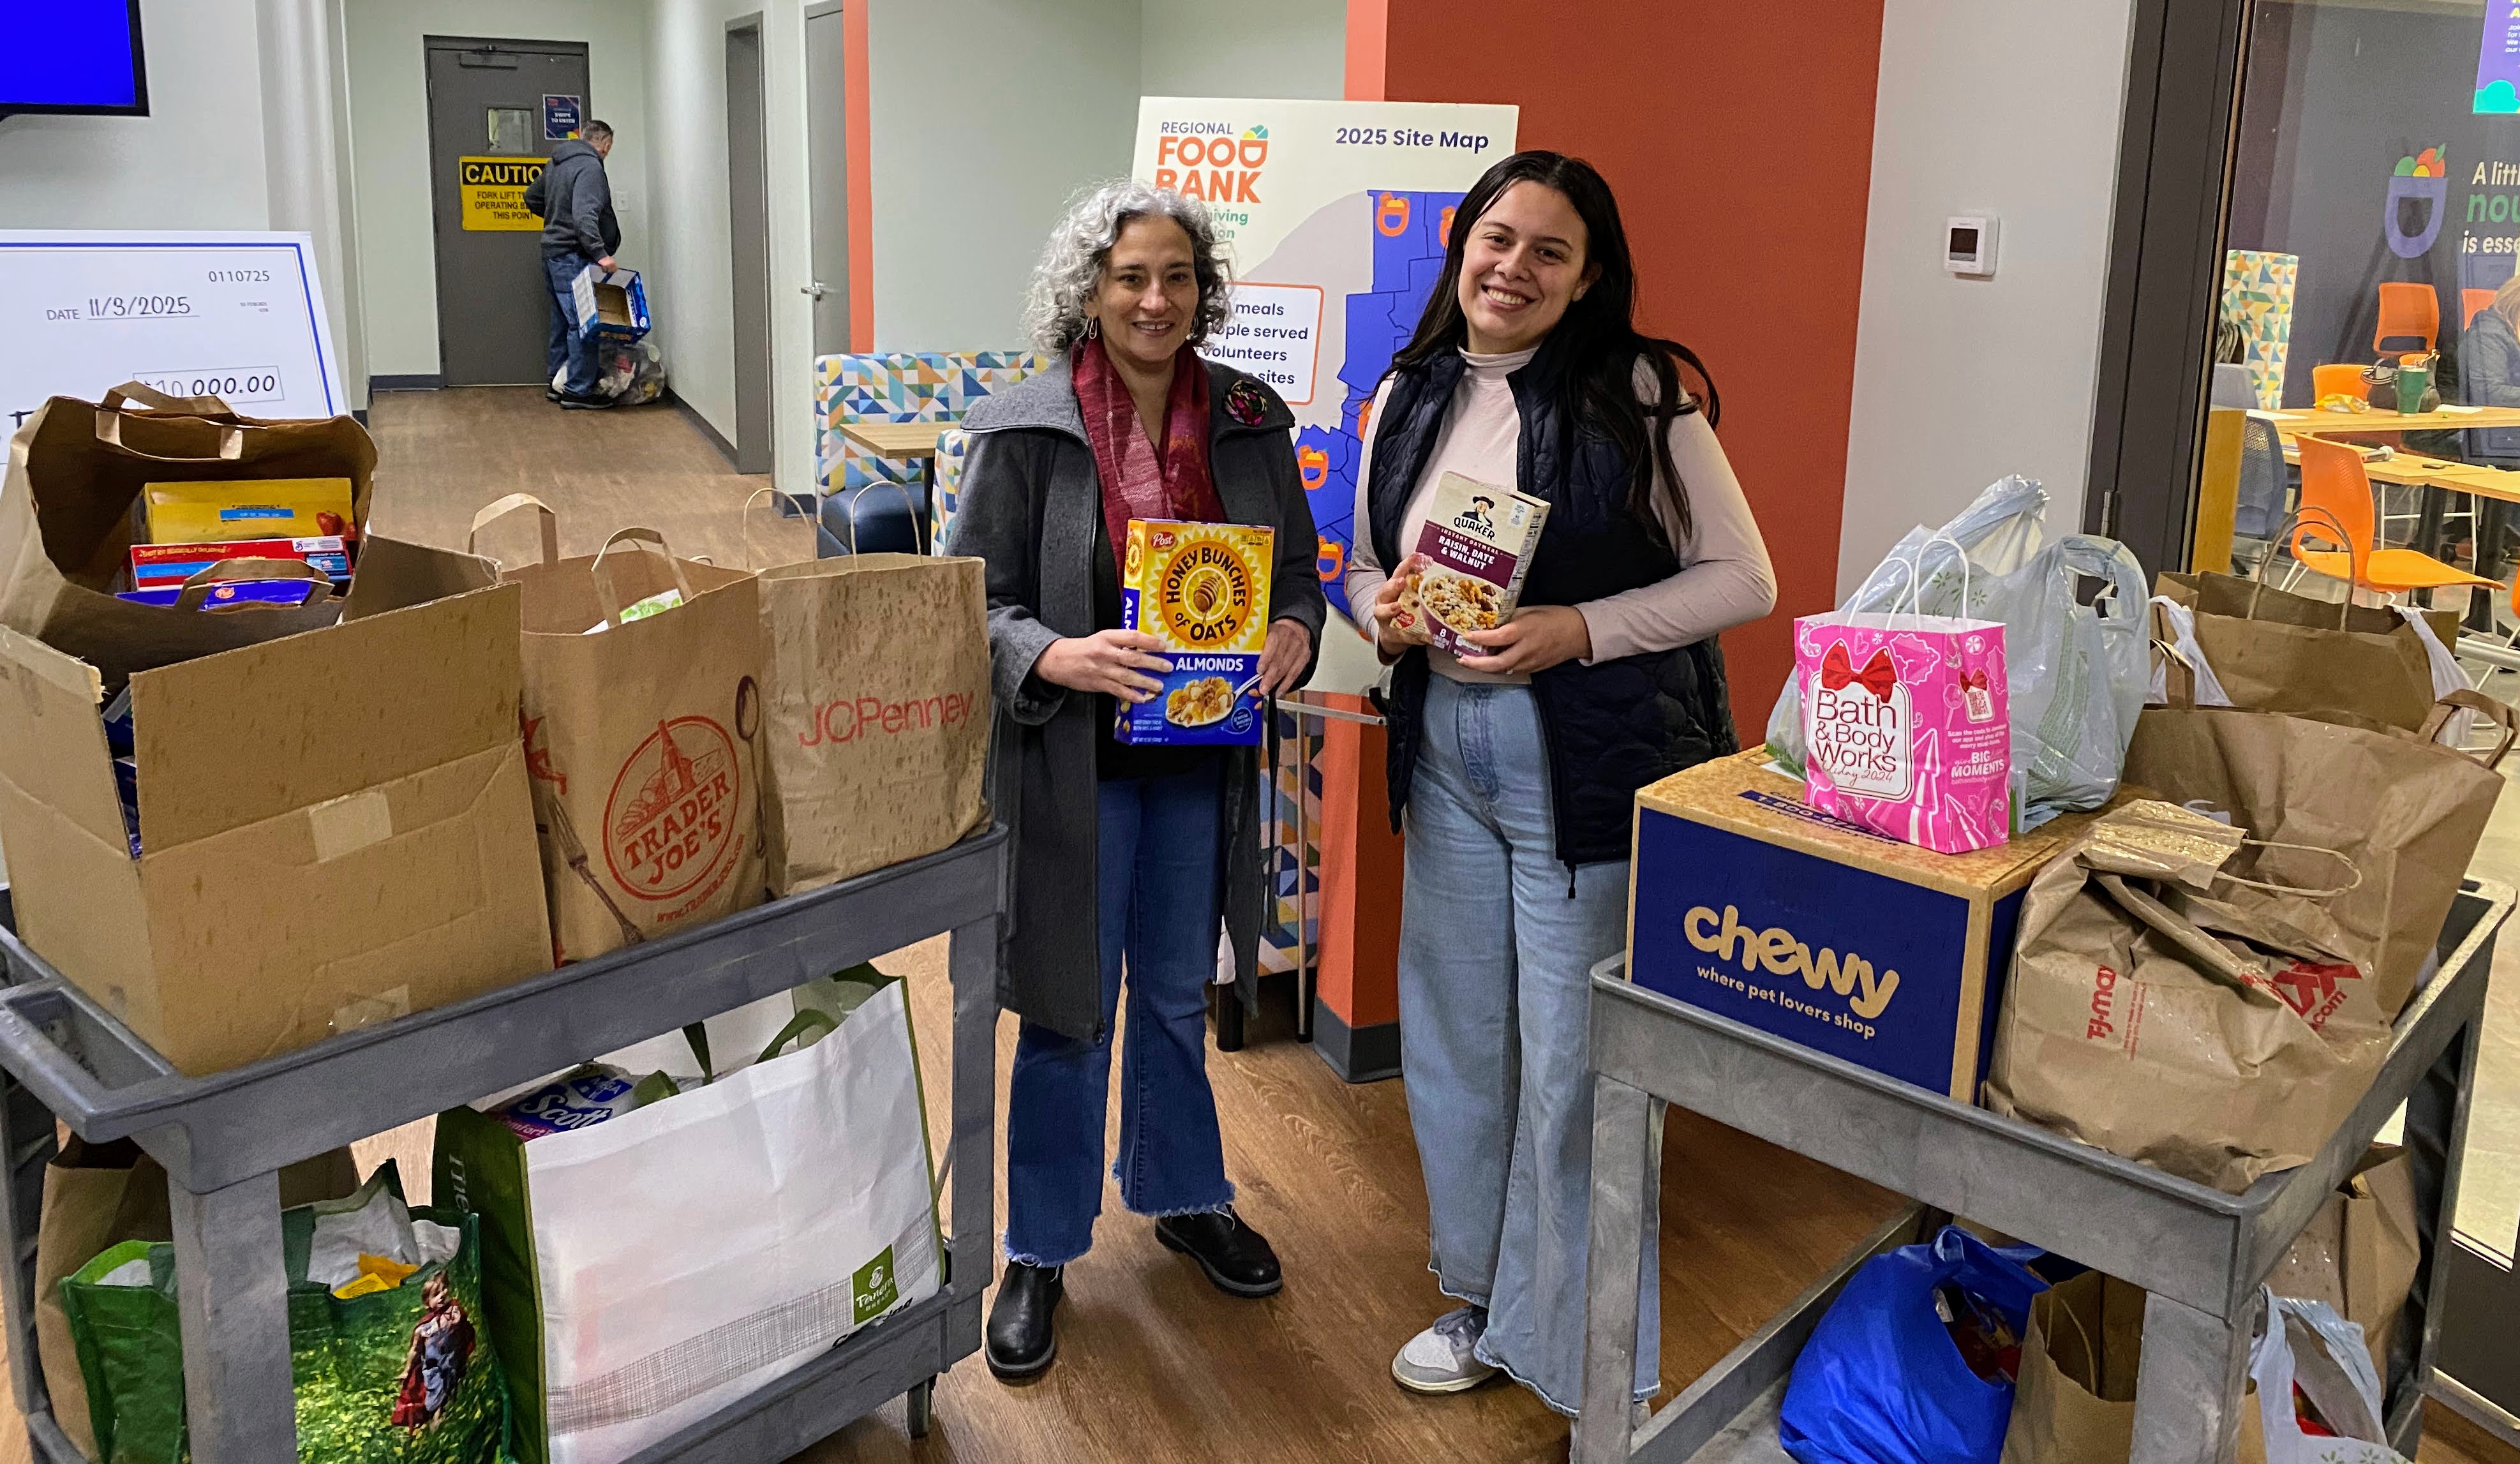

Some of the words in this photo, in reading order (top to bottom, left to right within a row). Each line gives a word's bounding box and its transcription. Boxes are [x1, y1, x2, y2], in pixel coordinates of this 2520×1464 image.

[1161, 122, 1233, 134] REGIONAL
[1158, 136, 1268, 168] FOOD
[1336, 128, 1387, 145] 2025
[1393, 130, 1433, 147] Site
[1440, 131, 1489, 153] Map
[466, 165, 542, 183] CAUTIO
[2472, 161, 2487, 184] A
[2491, 161, 2520, 185] littl
[1156, 168, 1262, 203] BANK
[1211, 209, 1249, 225] iving
[1214, 226, 1235, 239] ion
[2462, 230, 2477, 253] is
[209, 271, 269, 282] 0110725
[47, 309, 80, 320] DATE
[1235, 303, 1284, 315] meals
[1226, 324, 1249, 339] ple
[1254, 327, 1308, 340] served
[1258, 370, 1295, 384] sites
[1152, 532, 1174, 547] Post
[1454, 517, 1495, 541] QUAKER
[1449, 549, 1486, 570] WALNUT
[1472, 549, 1495, 564] DATE
[1167, 550, 1197, 604] HONEY
[1202, 547, 1246, 607] BUNCHES
[1190, 614, 1237, 640] OATS
[1440, 628, 1447, 637] 8
[1176, 657, 1244, 671] ALMONDS
[798, 691, 974, 746] JCPenney
[1817, 690, 1896, 729] Bath
[1815, 721, 1831, 741] &
[1835, 724, 1895, 753] Body
[1815, 738, 1896, 773] Works
[1971, 751, 1990, 764] BIG
[1861, 770, 1892, 783] 2024
[1951, 759, 2004, 778] MOMENTS
[624, 771, 731, 870] TRADER
[647, 809, 722, 885] JOE'S
[1684, 905, 1900, 1019] chewy
[1697, 966, 1744, 992] where
[1748, 985, 1776, 1004] pet
[1779, 992, 1830, 1022] lovers
[1835, 1013, 1875, 1040] shop
[518, 1094, 611, 1128] Scott
[856, 1277, 893, 1308] Panera
